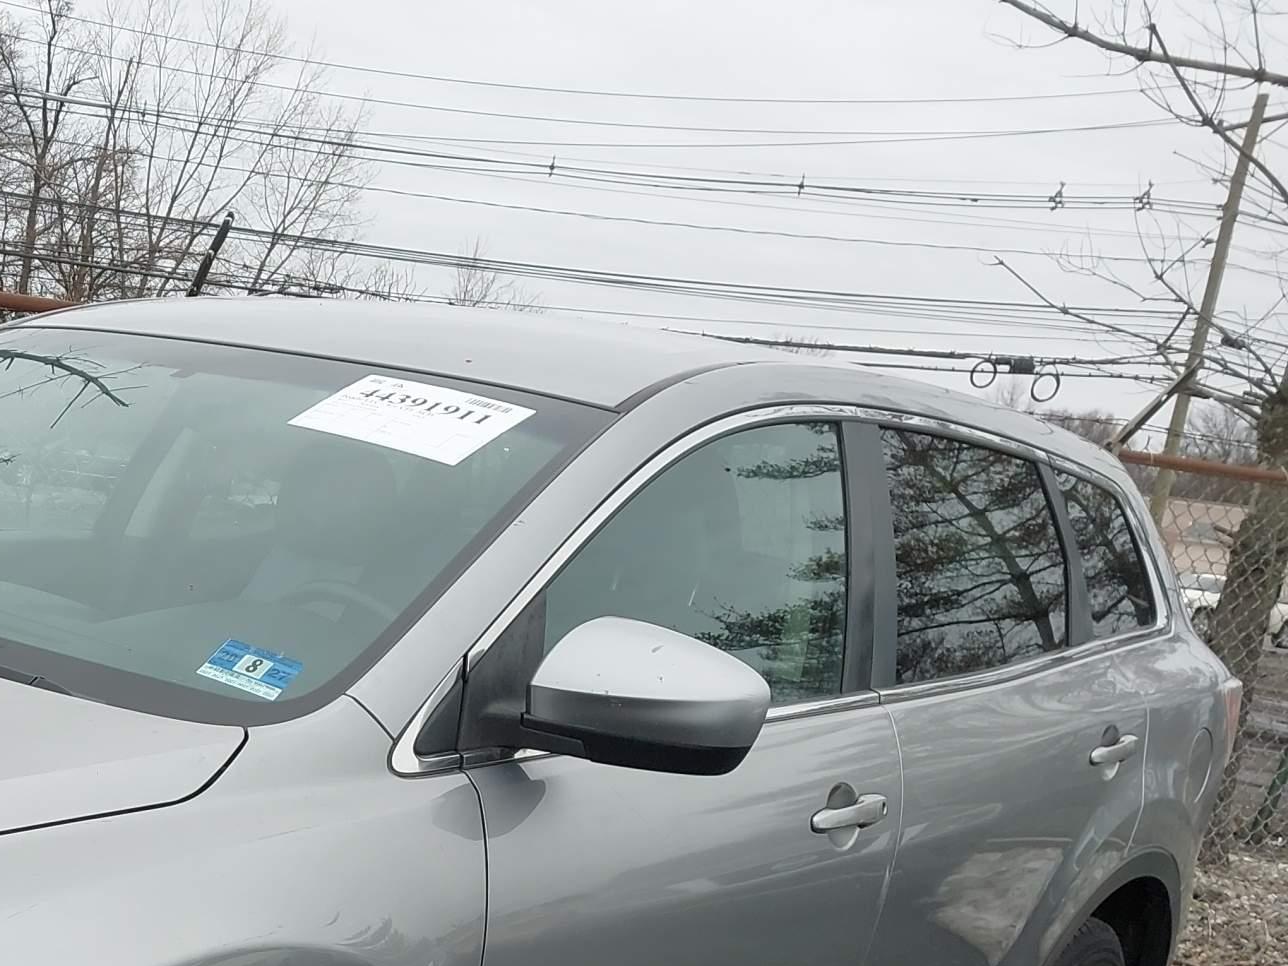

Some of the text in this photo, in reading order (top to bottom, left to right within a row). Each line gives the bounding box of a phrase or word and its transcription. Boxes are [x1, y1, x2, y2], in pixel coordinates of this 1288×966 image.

[359, 388, 492, 425] 44391911
[245, 658, 264, 673] 8
[269, 668, 290, 681] 27
